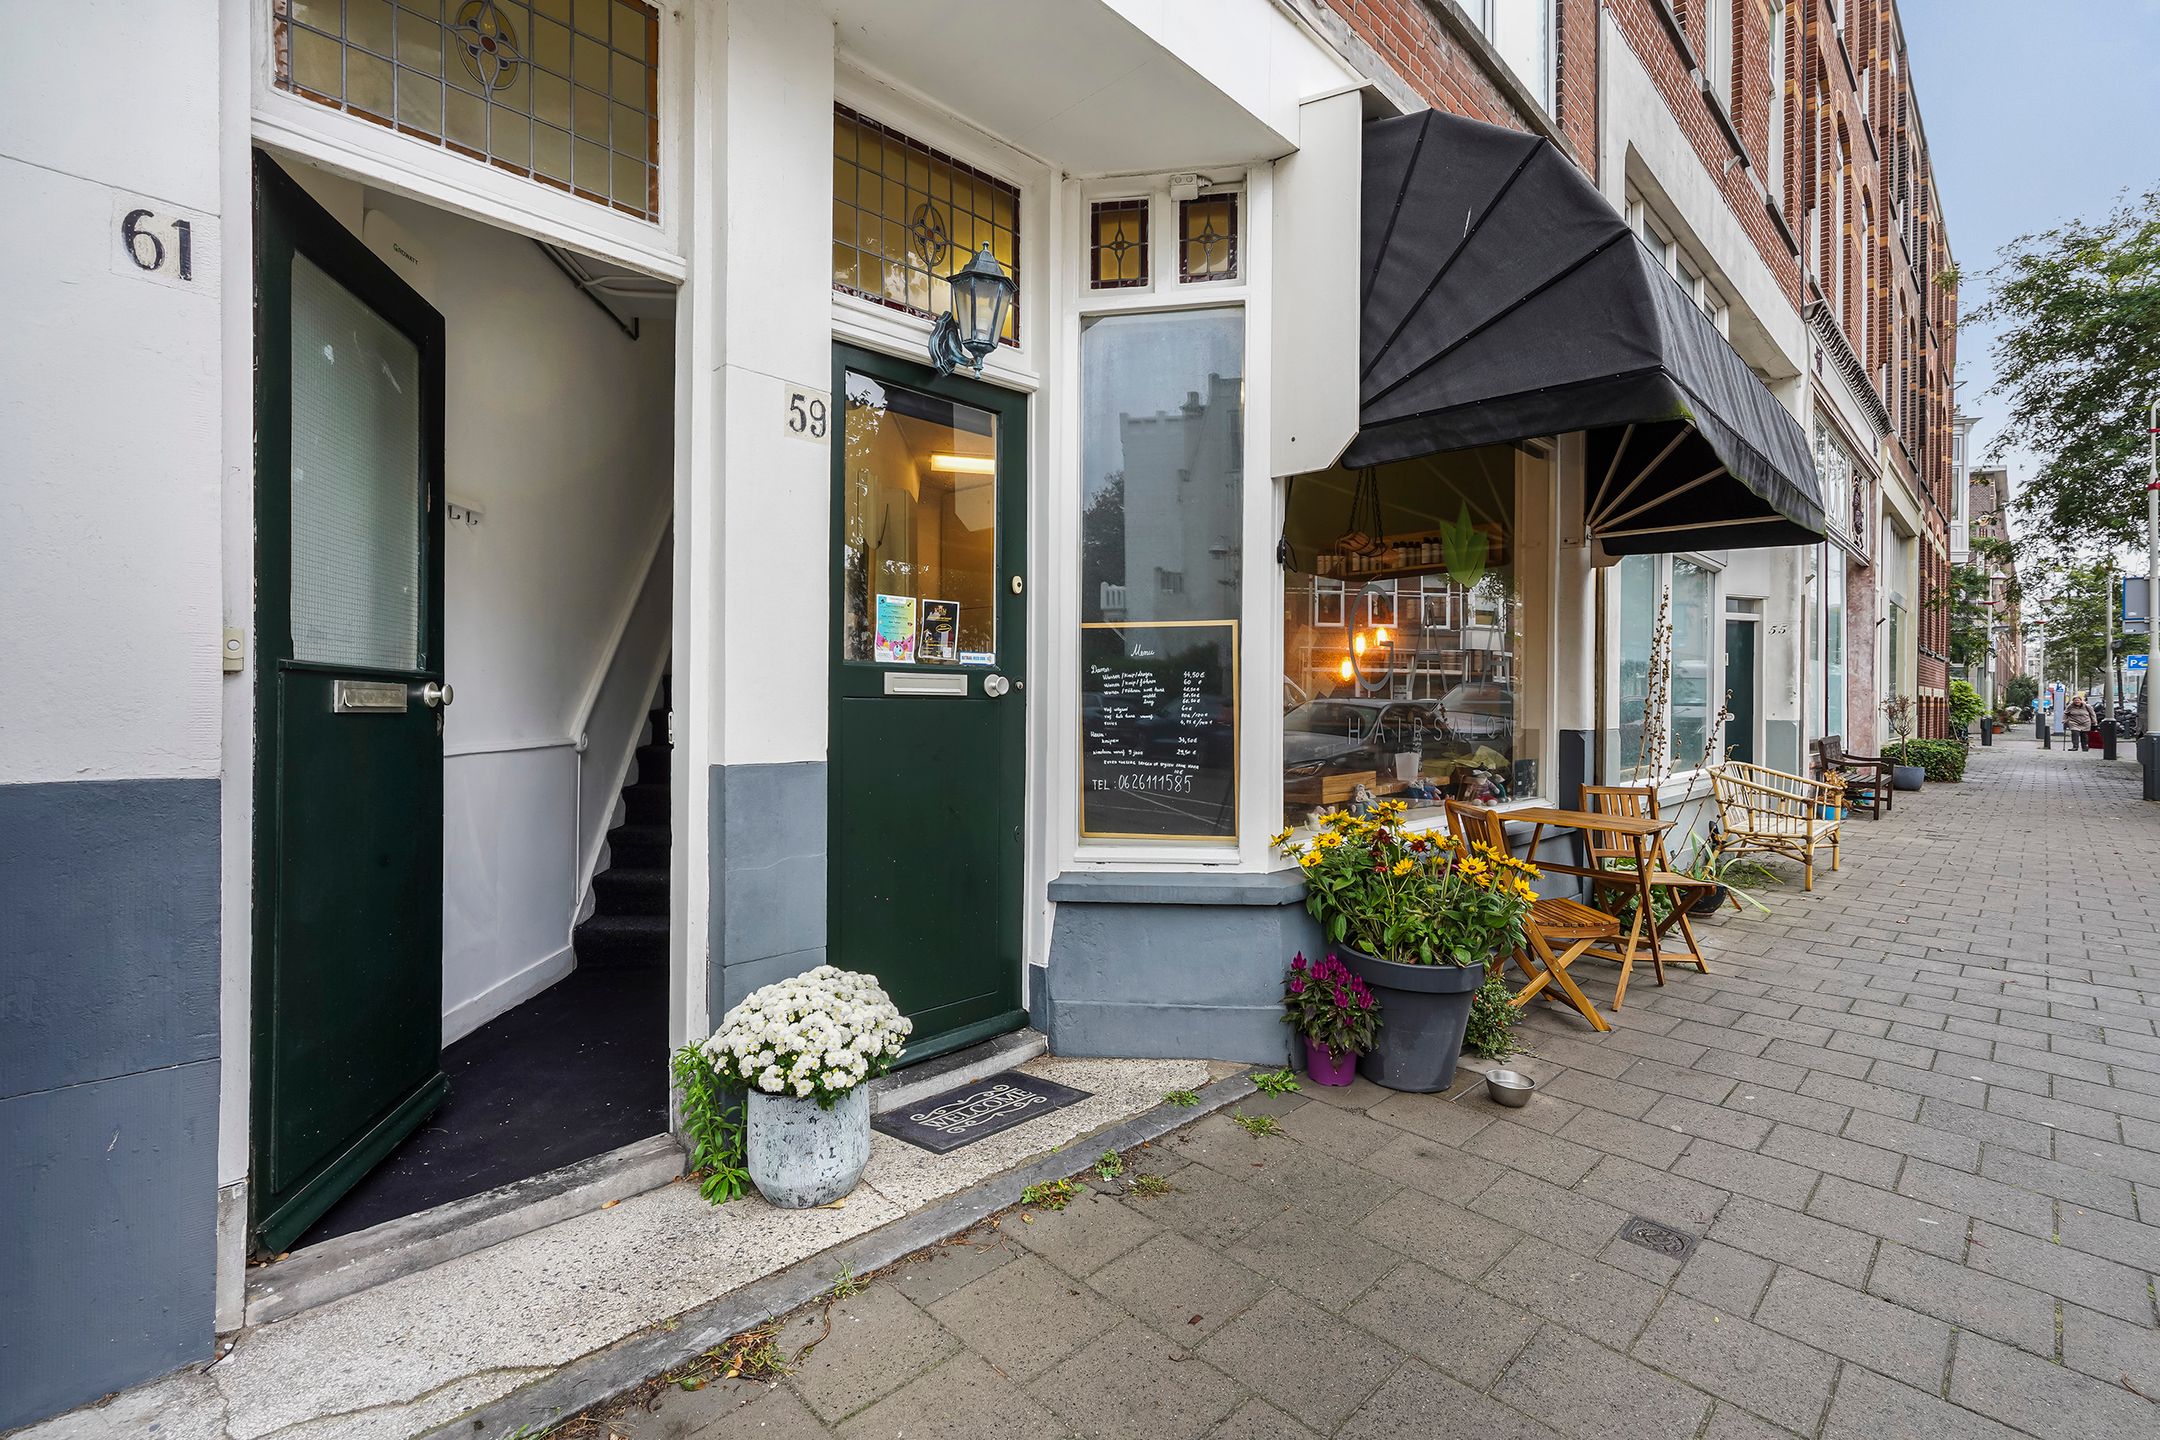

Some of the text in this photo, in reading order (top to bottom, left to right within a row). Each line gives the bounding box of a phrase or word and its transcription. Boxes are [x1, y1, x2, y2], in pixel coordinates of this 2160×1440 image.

[121, 208, 192, 281] 61
[789, 393, 826, 438] 59
[1768, 624, 1788, 635] 55
[1130, 643, 1155, 657] Menu
[2130, 659, 2138, 667] P
[1434, 715, 1513, 742] SALON
[1118, 773, 1194, 794] 0626111585
[925, 1086, 1034, 1130] WELCOME
